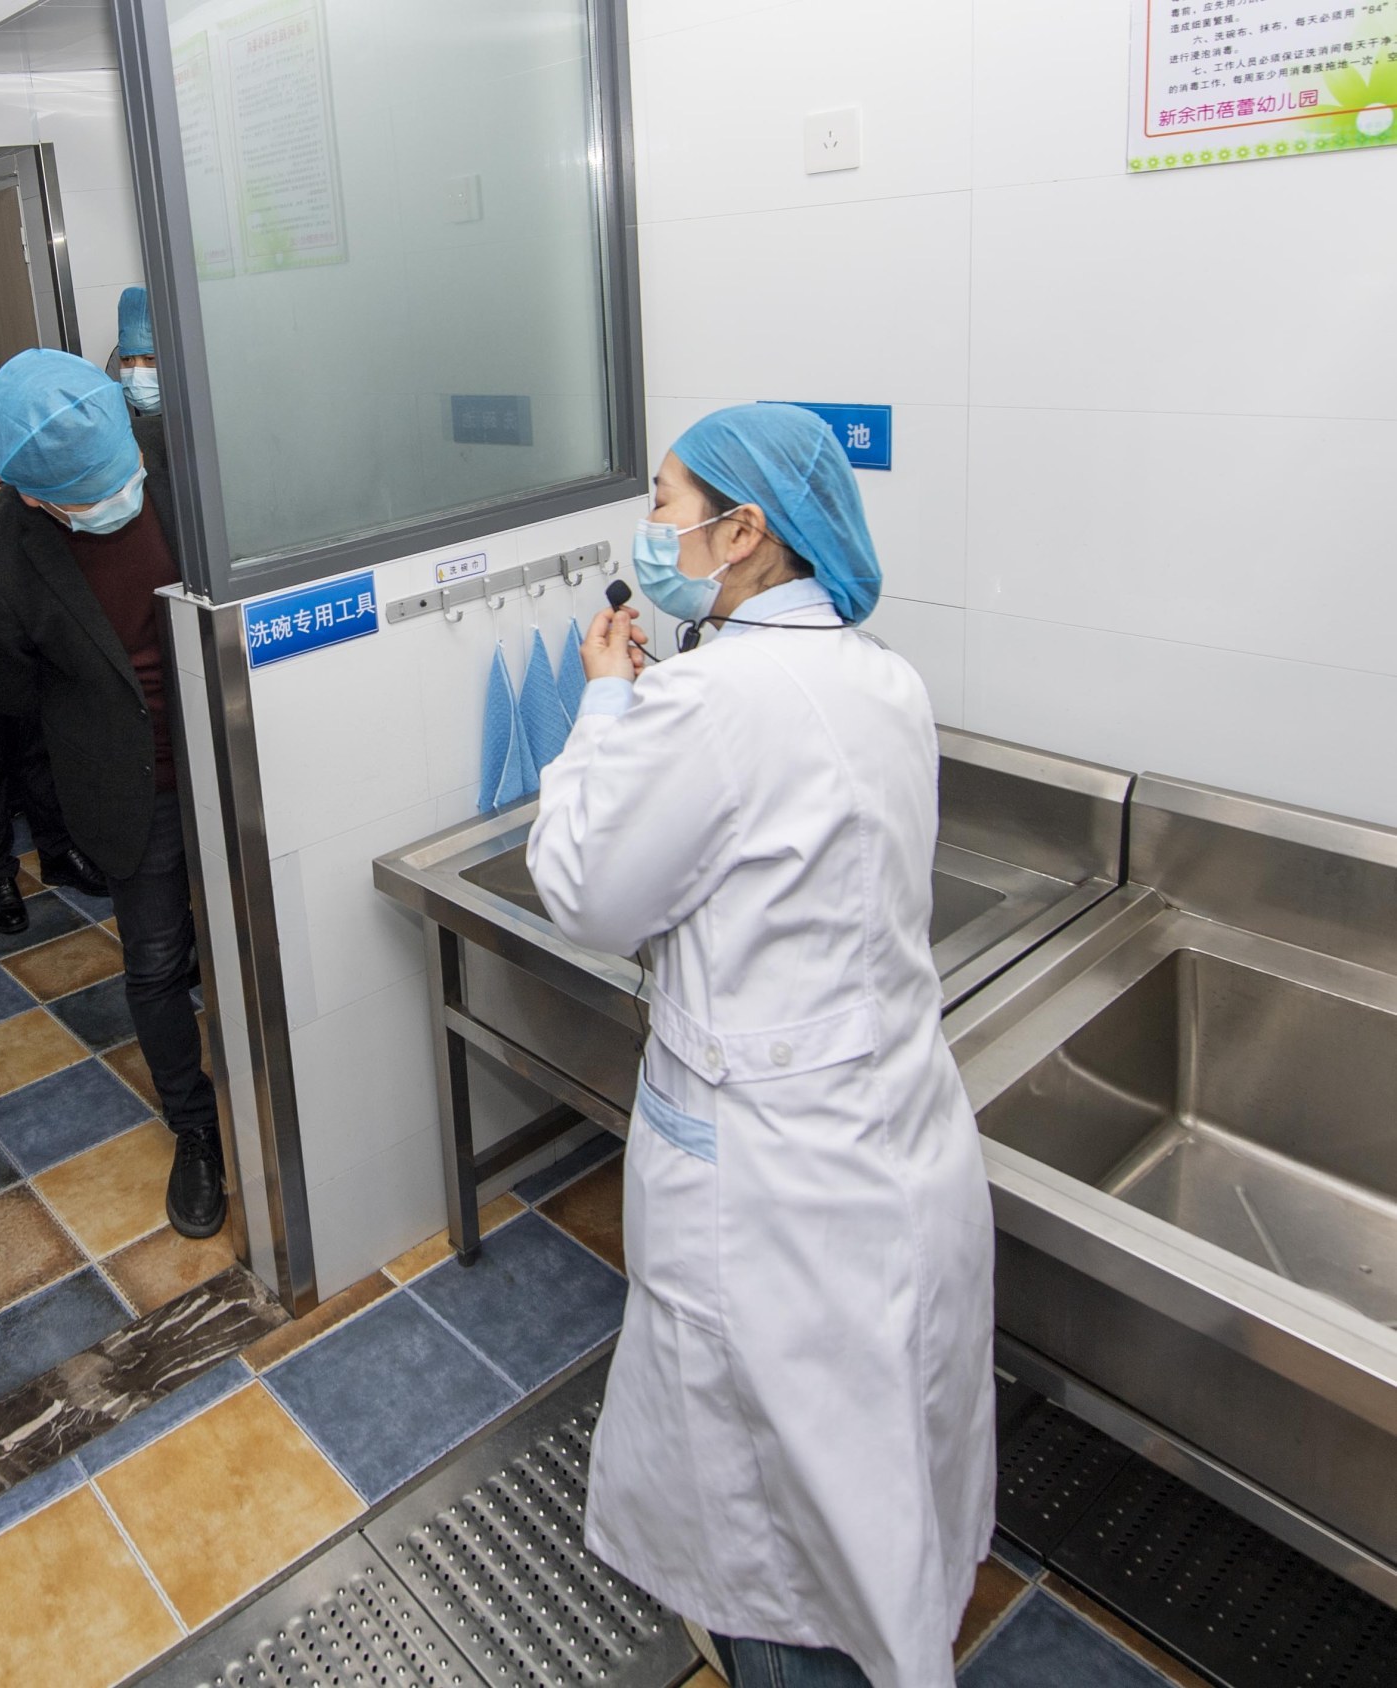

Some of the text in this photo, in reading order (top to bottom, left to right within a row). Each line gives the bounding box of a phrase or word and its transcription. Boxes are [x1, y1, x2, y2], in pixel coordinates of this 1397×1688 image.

[1193, 2, 1397, 45] 六、洗碗布、抹布，每天必须用“84”
[1192, 35, 1397, 75] 七、工作人员必须保证洗消间每天干净
[1158, 89, 1318, 127] 新余市蓓蕾幼儿园
[249, 591, 376, 648] 洗碗专用工具
